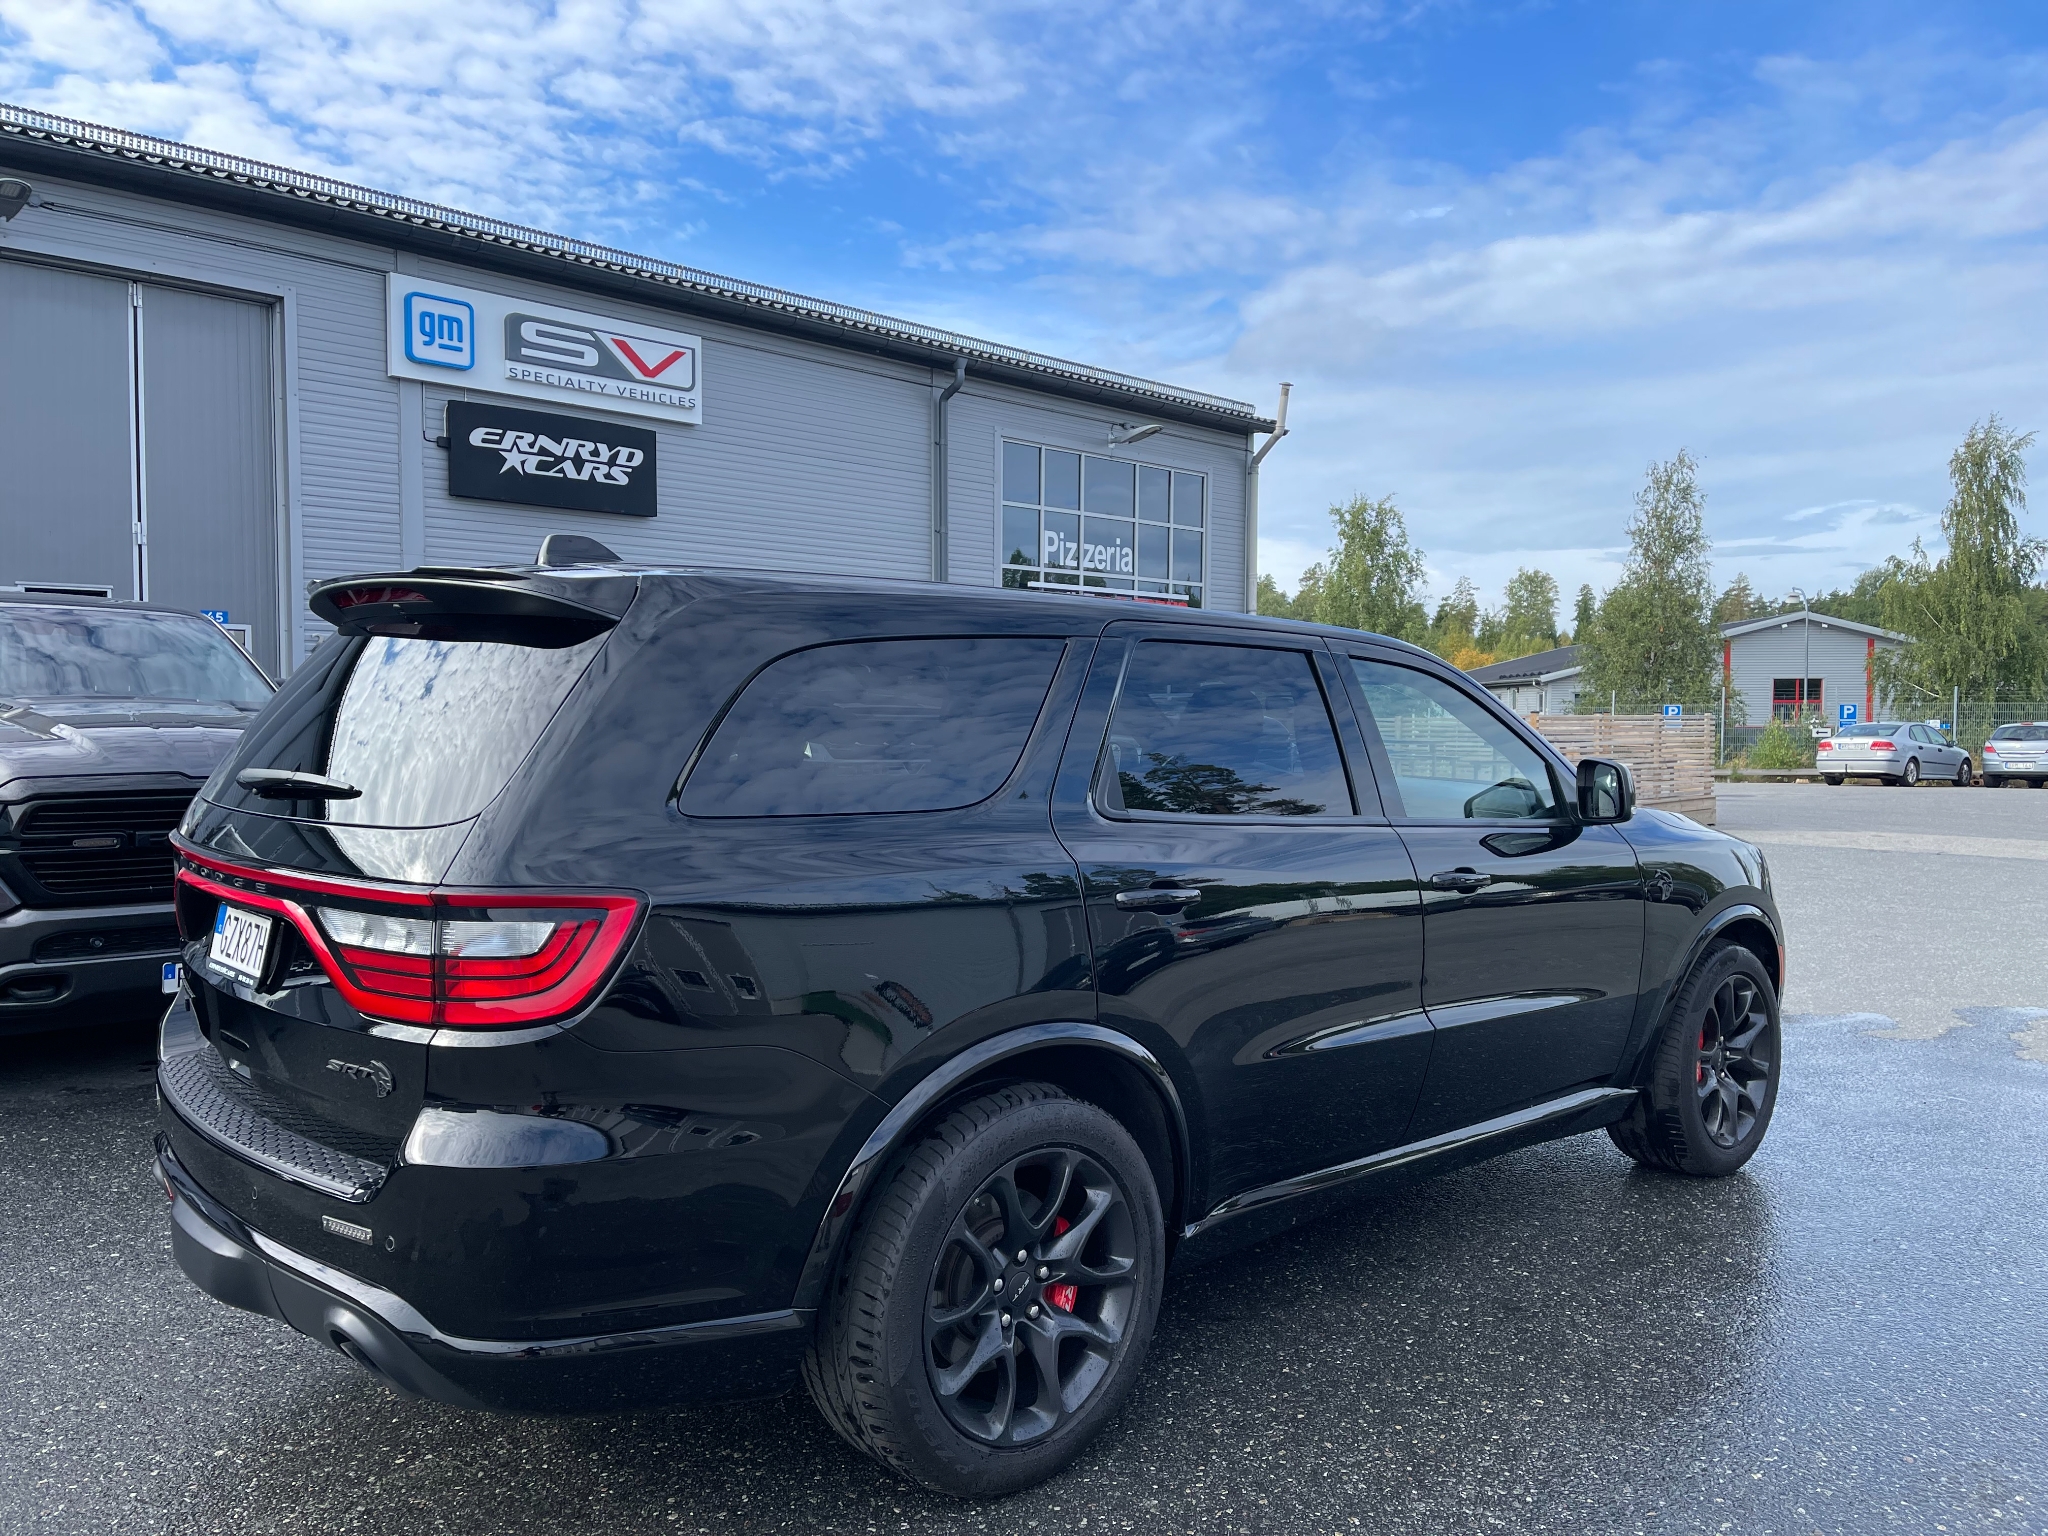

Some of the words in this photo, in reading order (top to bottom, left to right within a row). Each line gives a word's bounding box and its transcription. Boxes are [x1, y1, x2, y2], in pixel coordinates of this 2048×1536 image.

[419, 310, 463, 347] gm
[521, 321, 687, 378] SV
[509, 367, 607, 393] SPECIALTY
[617, 386, 696, 408] VEHICLES
[469, 427, 644, 467] ERNRYD
[524, 456, 633, 486] CARS
[1044, 530, 1133, 573] Pizzeria
[1668, 706, 1679, 716] P
[1843, 706, 1855, 719] P
[188, 862, 267, 893] DODGE
[326, 1059, 375, 1079] SRT
